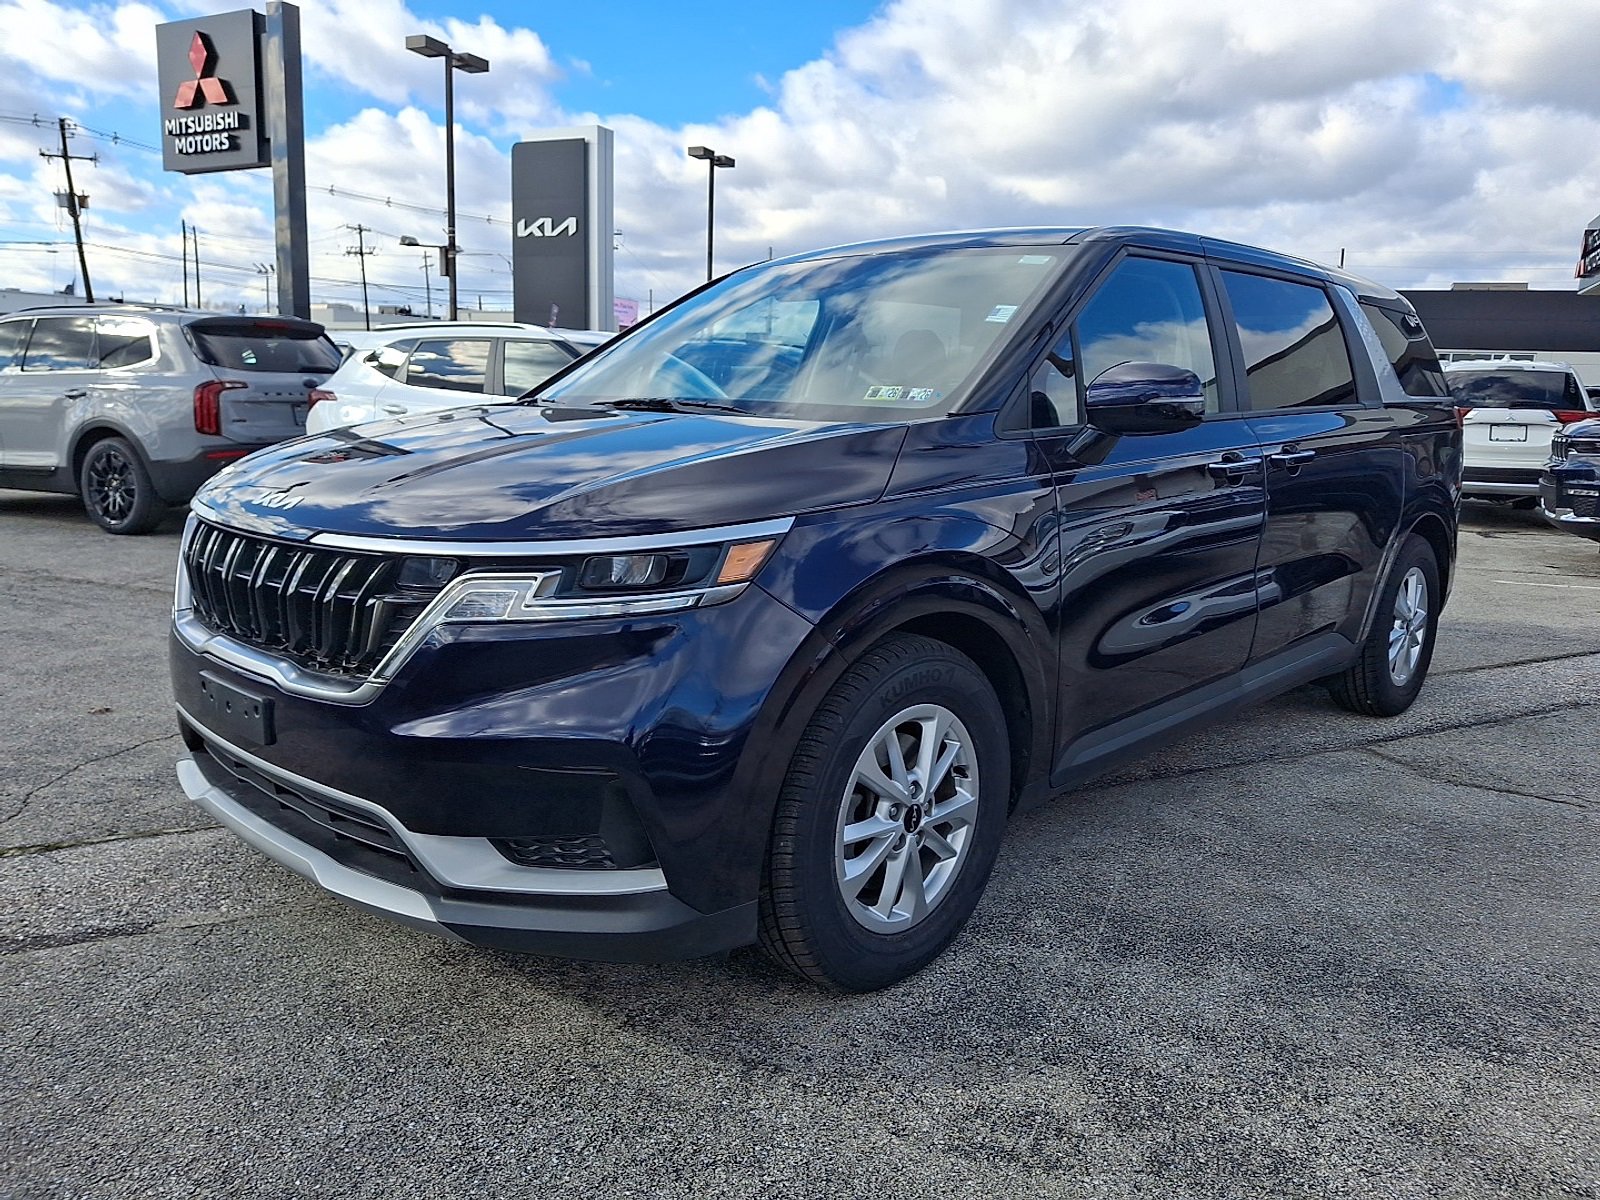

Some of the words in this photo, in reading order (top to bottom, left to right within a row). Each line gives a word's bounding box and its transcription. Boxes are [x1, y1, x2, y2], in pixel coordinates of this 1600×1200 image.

[165, 112, 239, 135] MITSUBISHI
[175, 132, 230, 154] MOTORS
[517, 217, 577, 237] KIA
[251, 491, 305, 511] KIA
[880, 667, 942, 709] KUMHO
